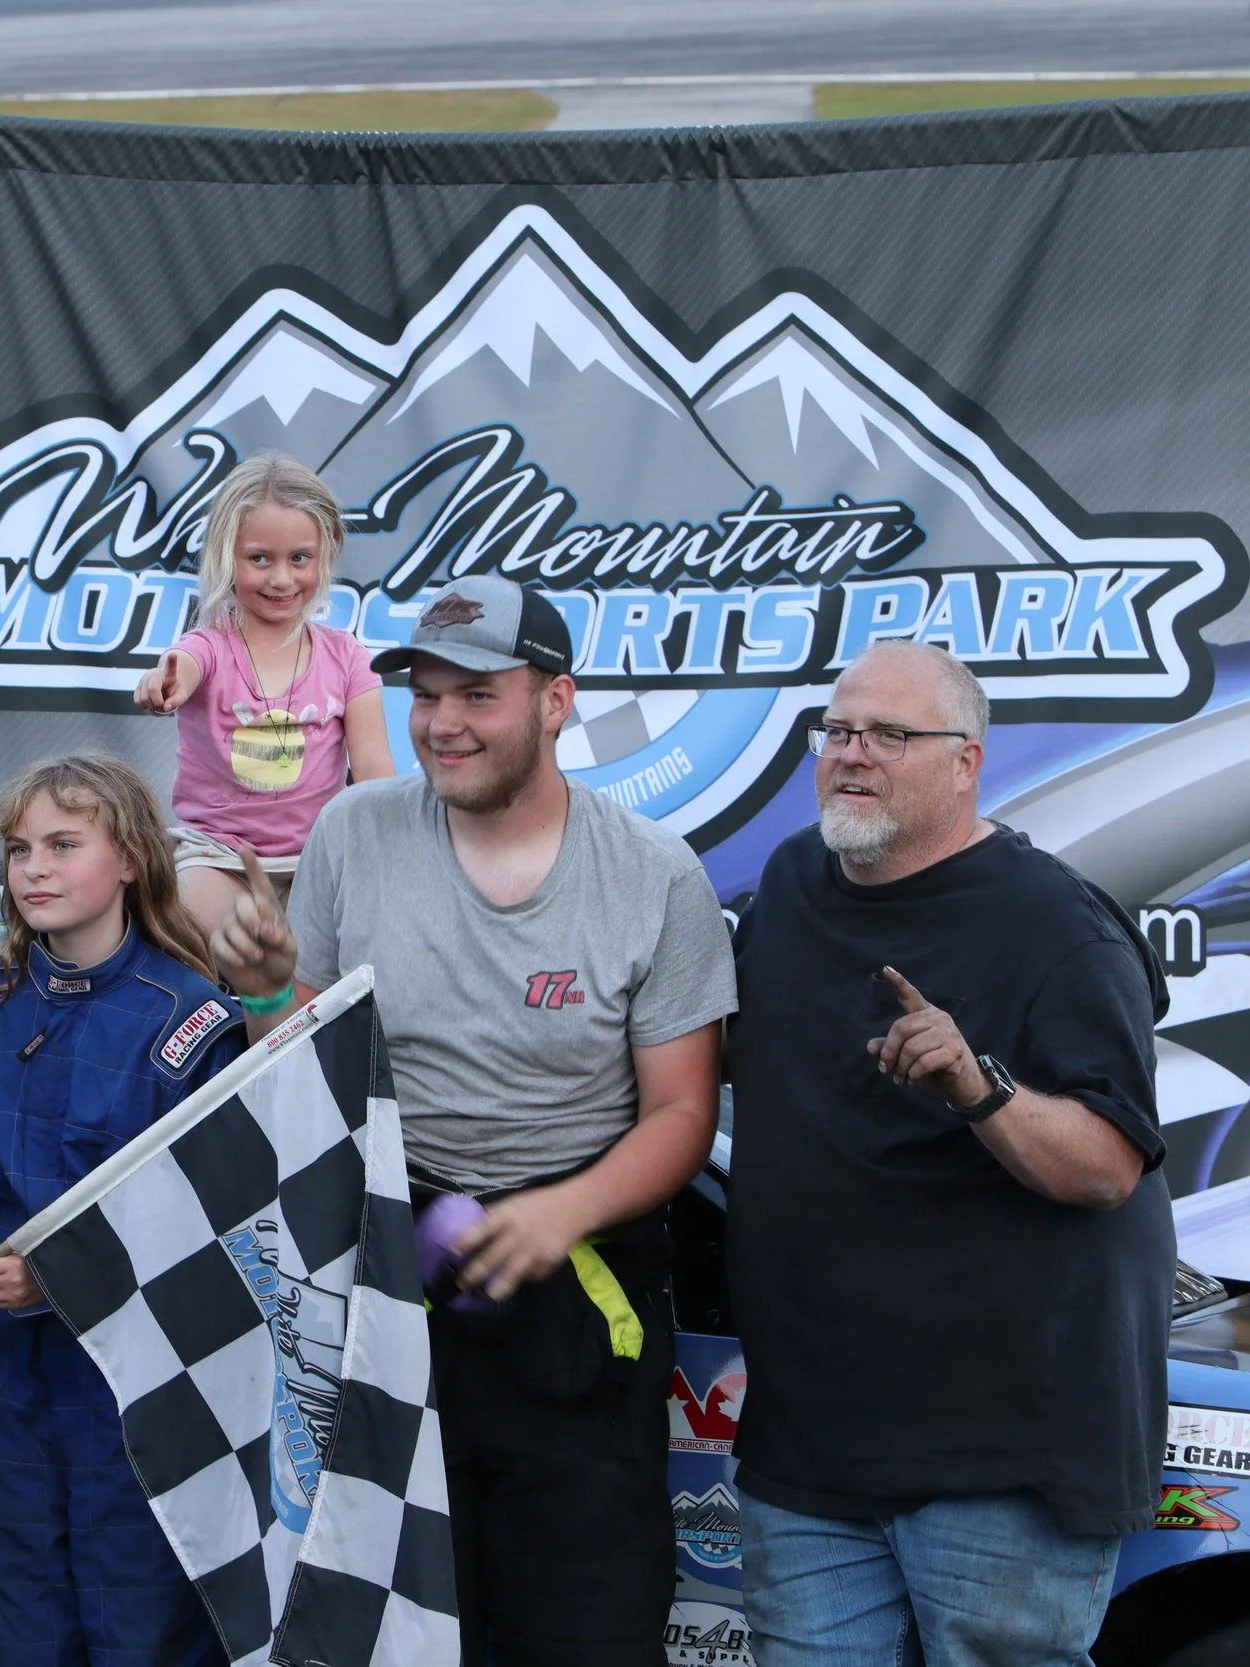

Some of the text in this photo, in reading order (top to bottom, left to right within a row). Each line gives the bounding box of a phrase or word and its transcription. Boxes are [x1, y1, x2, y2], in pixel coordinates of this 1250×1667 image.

[370, 426, 916, 592] Mountain
[824, 566, 1173, 671] PARK
[524, 969, 577, 1010] 17
[163, 1002, 218, 1060] G-FORCE
[174, 1014, 223, 1065] RACING GEAR
[1183, 1445, 1250, 1471] GEAR
